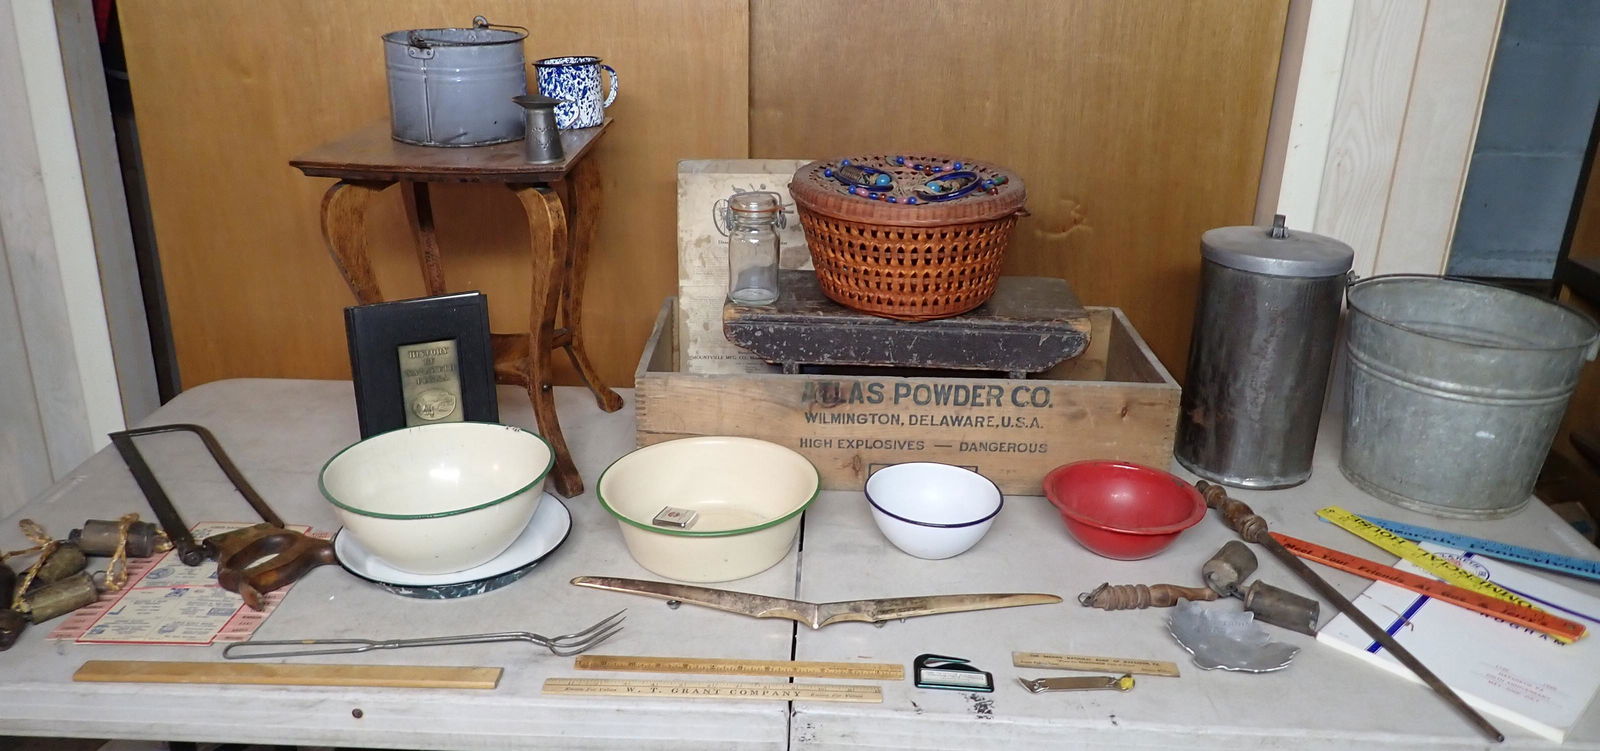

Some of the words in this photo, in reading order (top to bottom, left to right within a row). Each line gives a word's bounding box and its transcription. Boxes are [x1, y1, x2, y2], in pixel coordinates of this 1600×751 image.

[408, 346, 449, 359] HISTORY
[801, 380, 885, 405] ATLAS
[893, 382, 1005, 408] POWDER
[1010, 384, 1054, 409] CO.
[804, 411, 905, 427] WILMINGTON,
[908, 414, 999, 429] DELAWARE,
[1000, 415, 1044, 430] U.S.A.
[799, 437, 833, 450] HIGH
[837, 439, 926, 451] EXPLOSIVES
[959, 441, 1049, 454] DANGEROUS
[1416, 547, 1534, 609] OMMERCIAL
[626, 686, 641, 694] W.
[671, 688, 721, 696] GRANT
[729, 689, 801, 698] COMPANY
